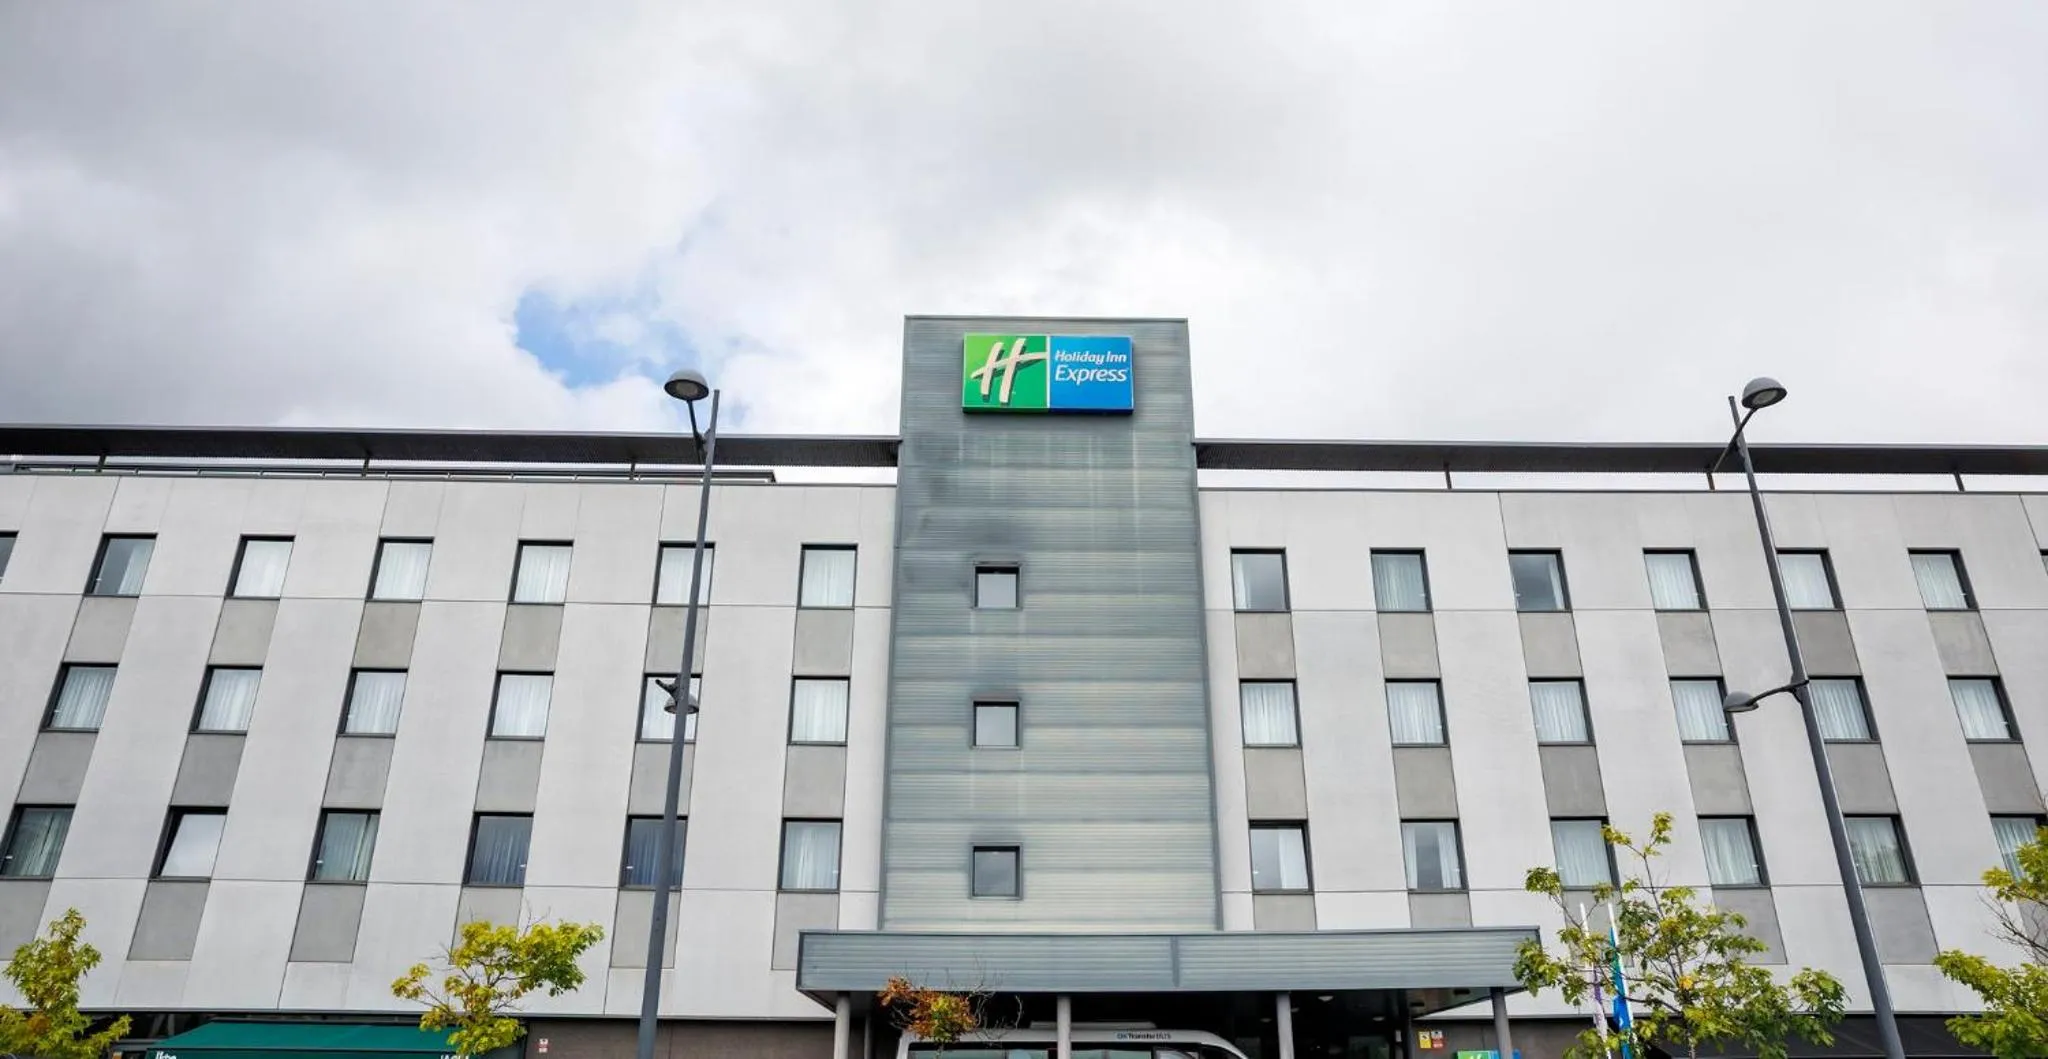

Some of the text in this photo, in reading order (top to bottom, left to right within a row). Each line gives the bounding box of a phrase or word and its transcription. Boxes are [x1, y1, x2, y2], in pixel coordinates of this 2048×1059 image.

[1055, 350, 1127, 365] Holiday Inn
[1055, 364, 1128, 386] Express
